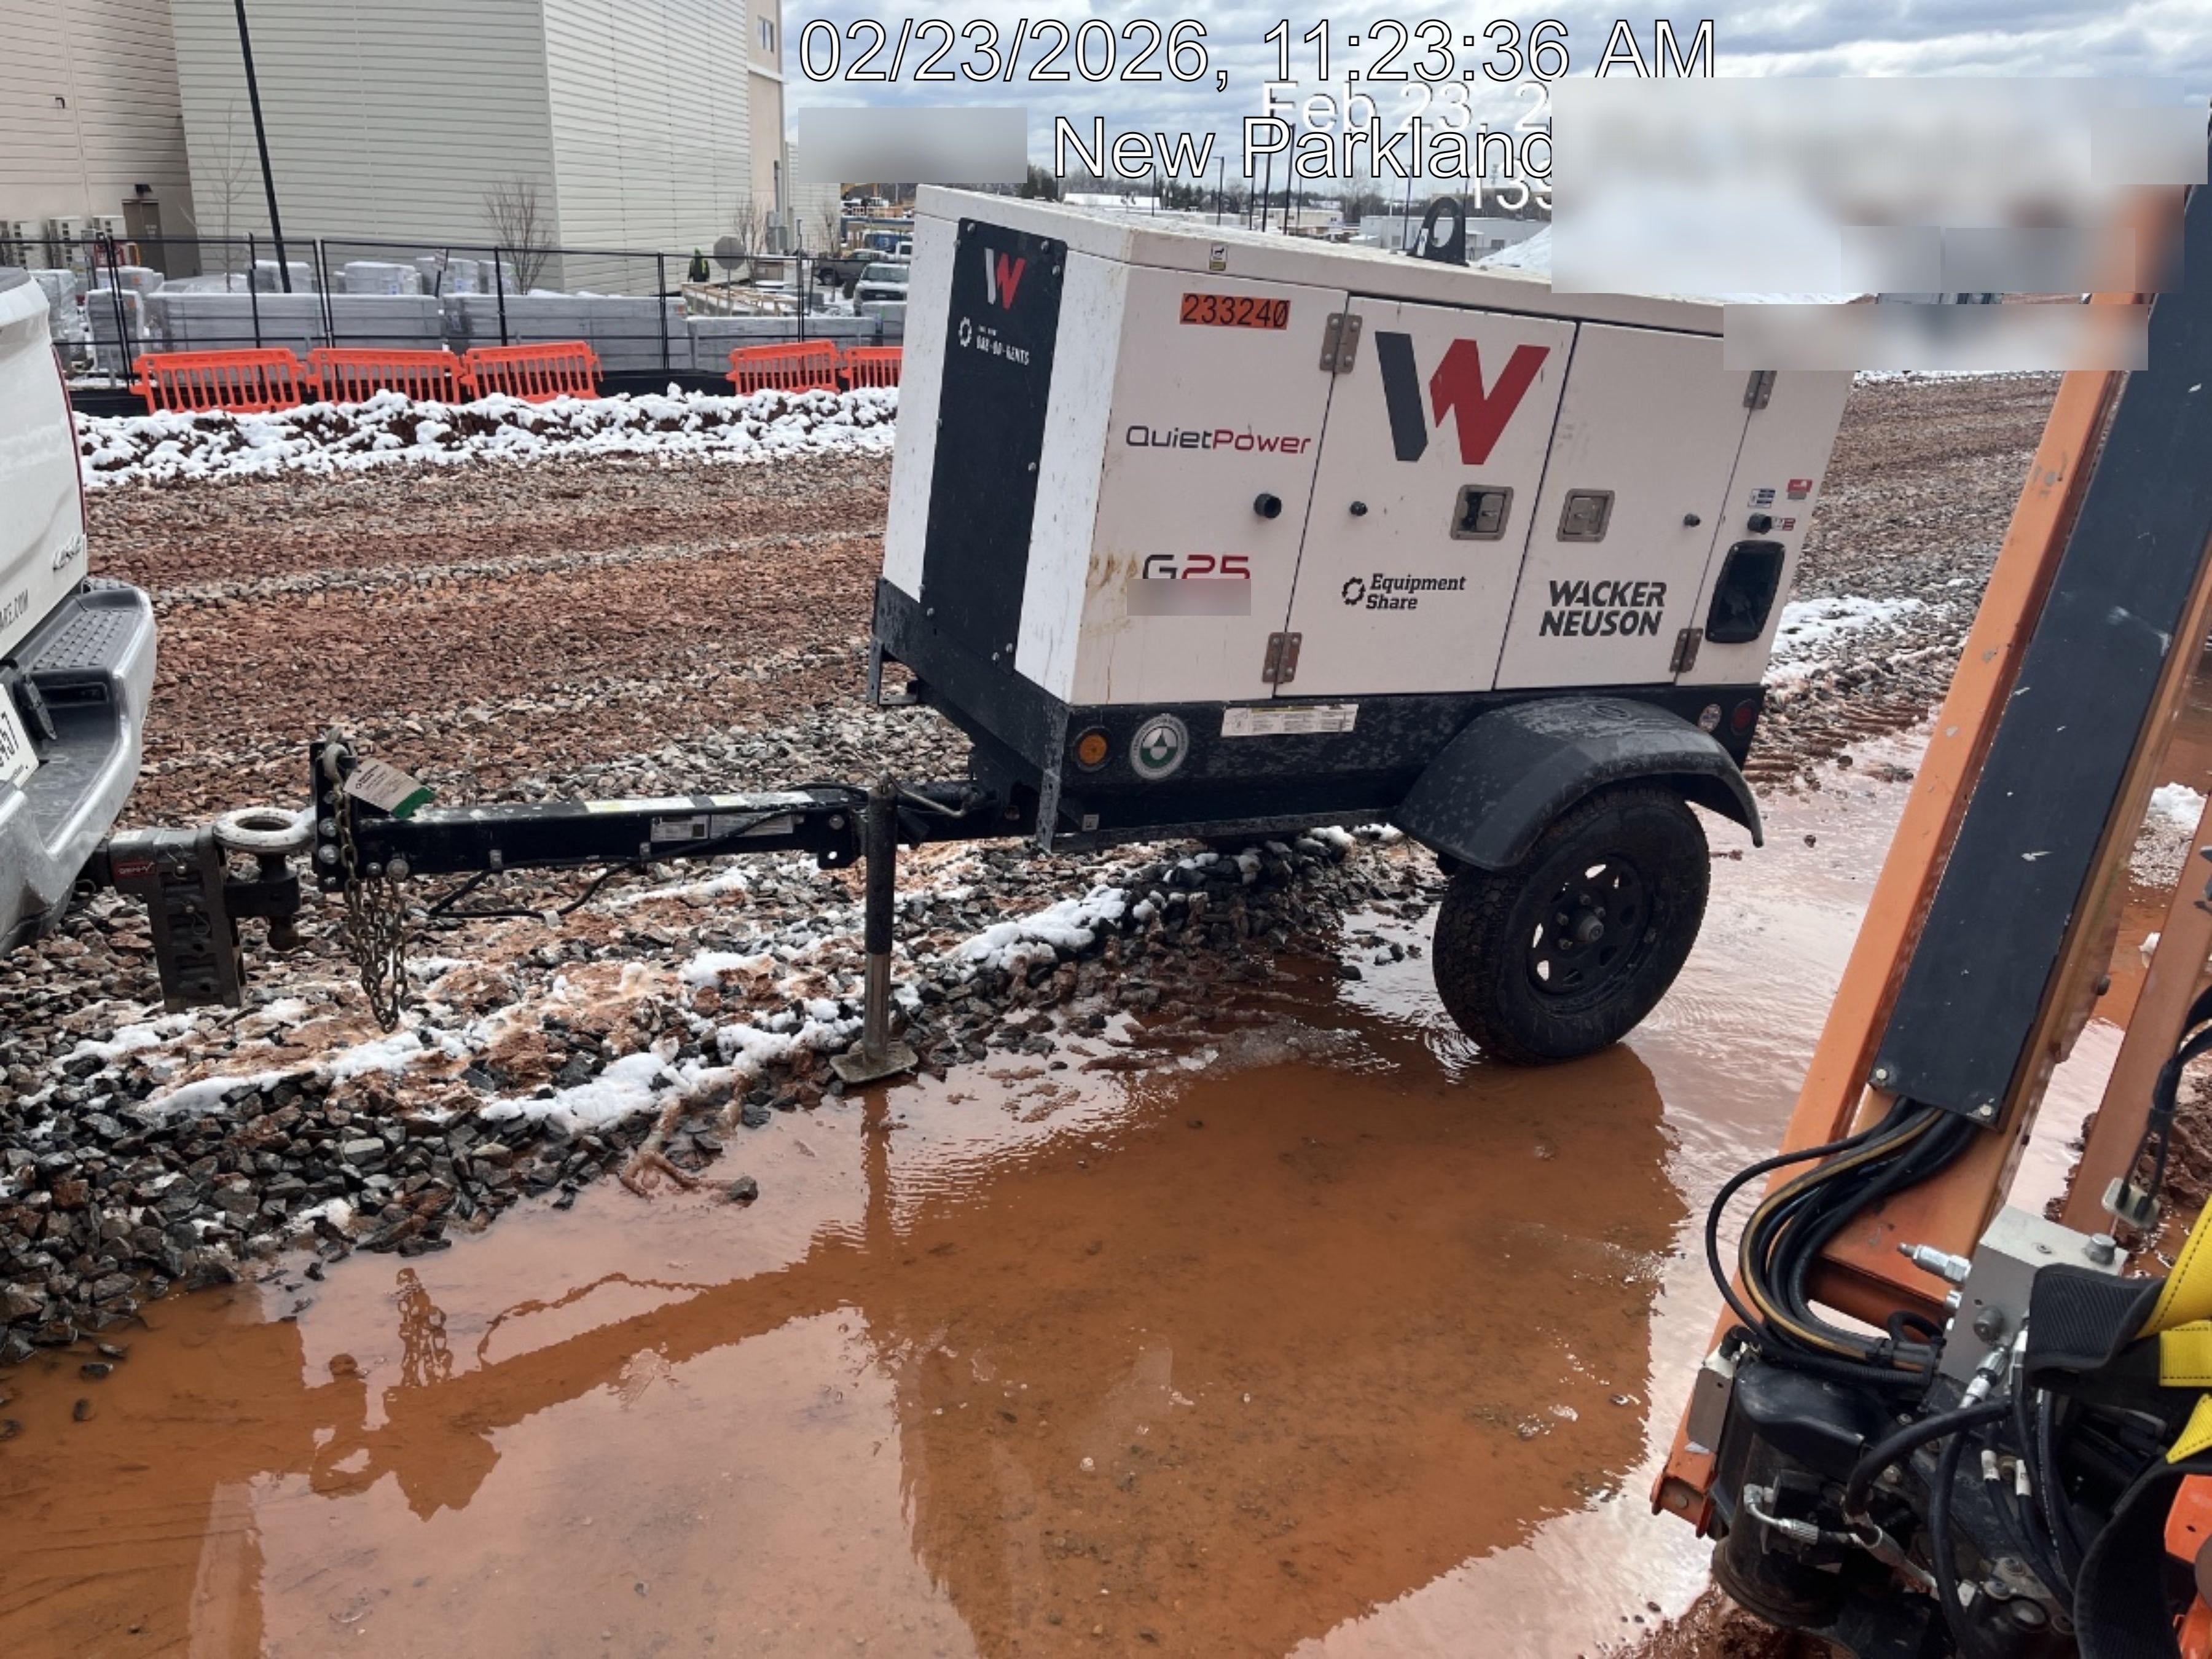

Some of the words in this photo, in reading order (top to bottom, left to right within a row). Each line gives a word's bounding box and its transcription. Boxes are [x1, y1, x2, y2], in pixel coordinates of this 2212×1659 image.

[1182, 293, 1290, 327] 233240
[1126, 425, 1311, 454] QuietPower
[1142, 554, 1251, 579] G25
[1370, 572, 1467, 594] Equipment
[1549, 580, 1667, 607] WACKER
[1365, 594, 1418, 610] Share
[1539, 610, 1663, 637] NEUSON
